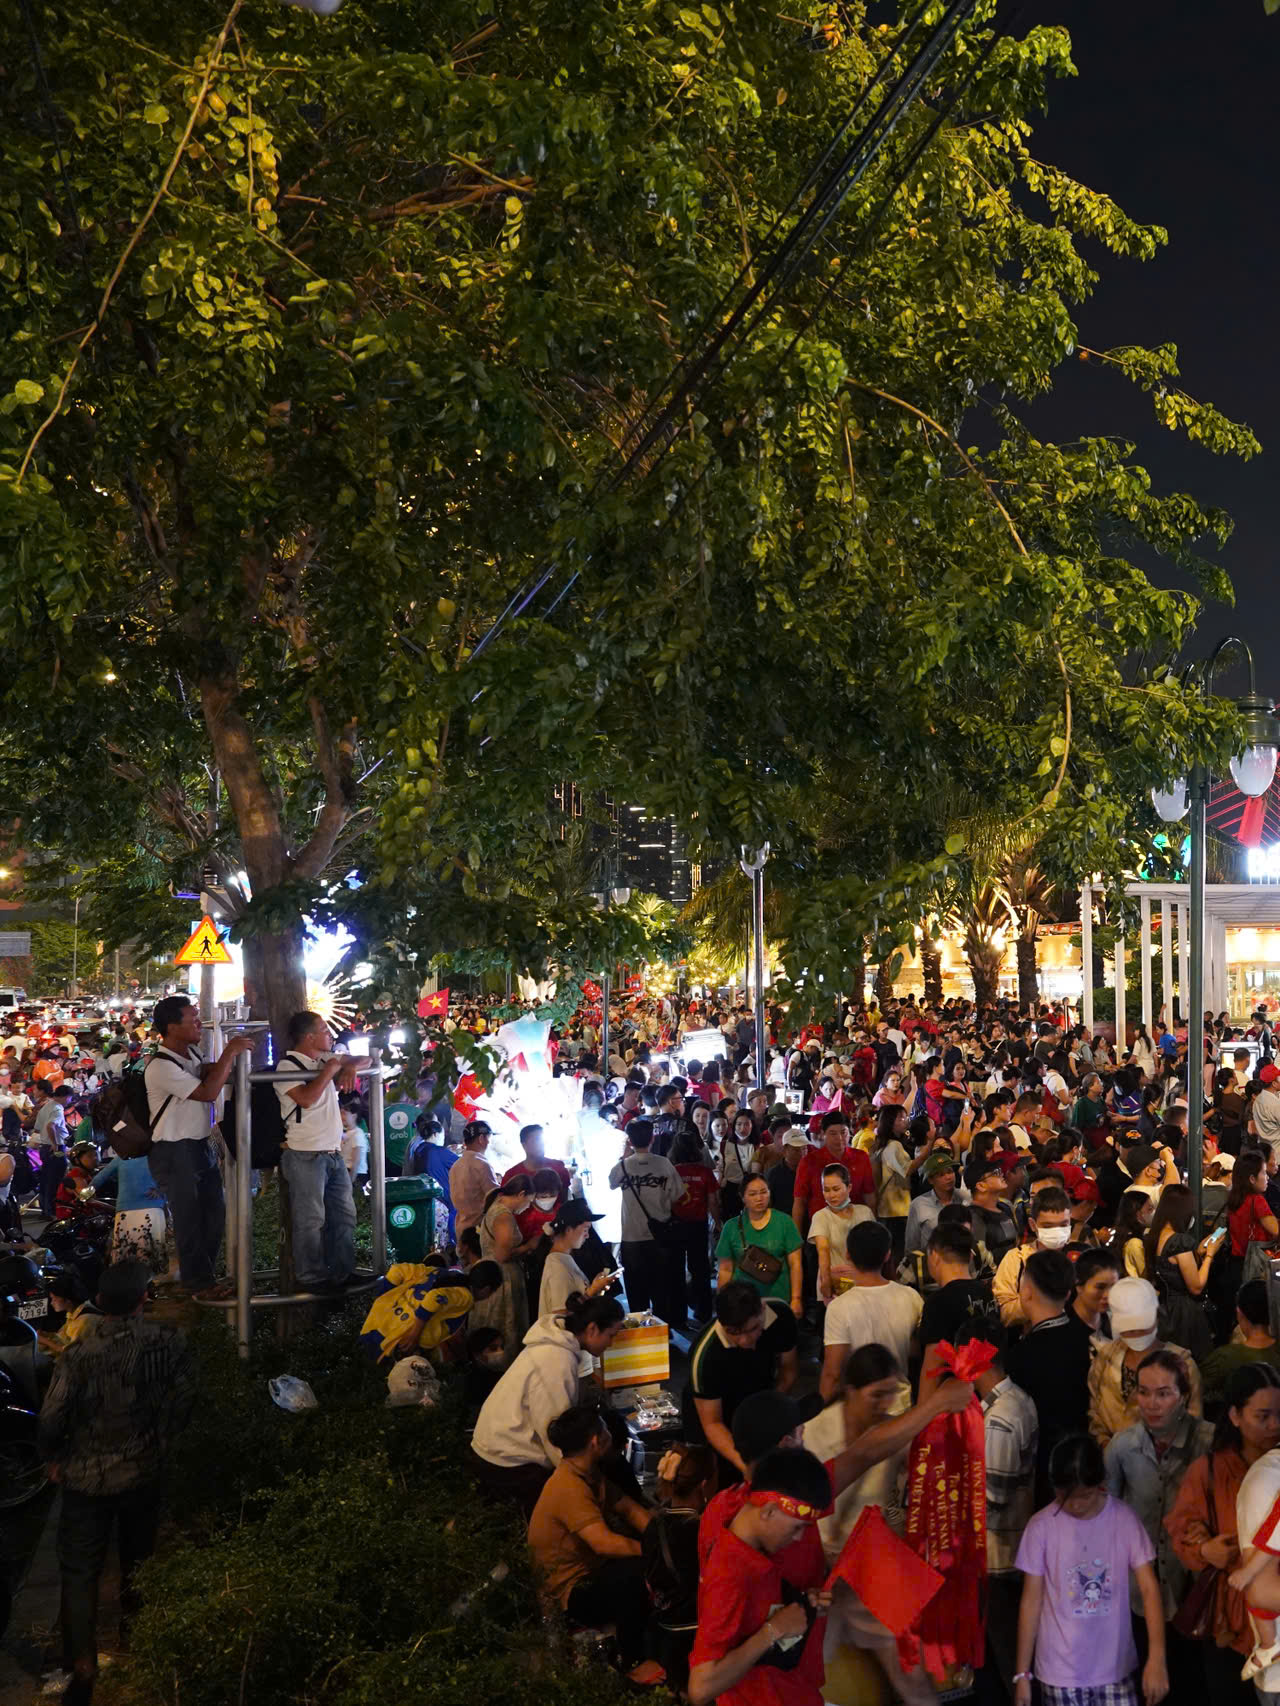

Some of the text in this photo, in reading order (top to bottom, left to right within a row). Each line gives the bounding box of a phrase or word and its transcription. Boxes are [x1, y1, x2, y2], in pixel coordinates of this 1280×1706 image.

[390, 1130, 408, 1140] Grab
[973, 1461, 982, 1488] NAM
[912, 1476, 925, 1503] VIỆT
[908, 1507, 920, 1533] NAM
[937, 1493, 949, 1520] VIỆT
[940, 1522, 949, 1550] NAM
